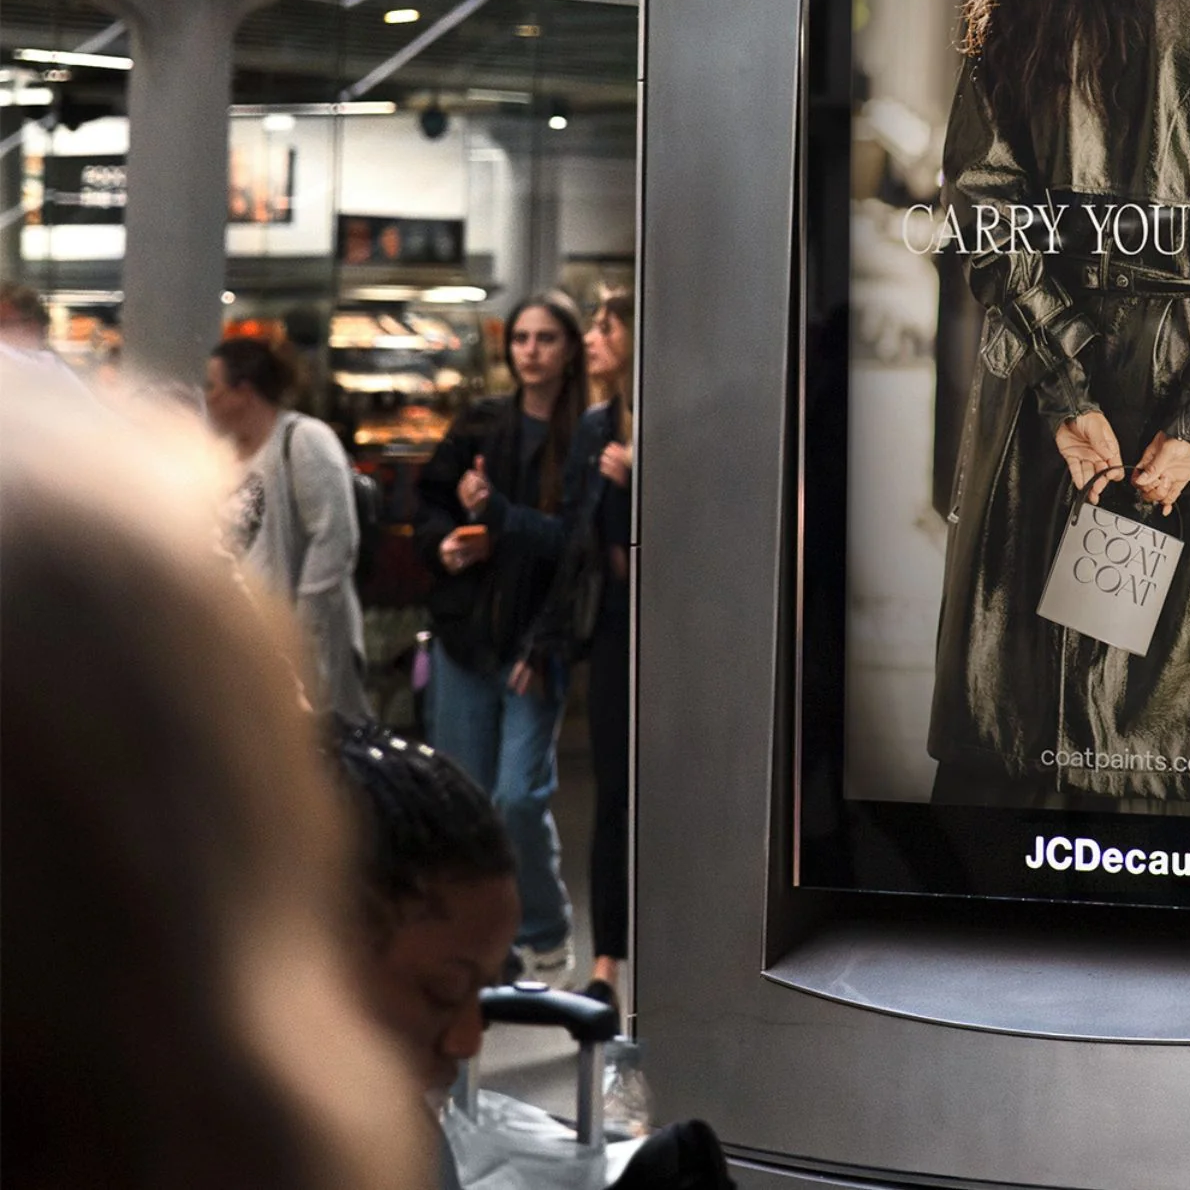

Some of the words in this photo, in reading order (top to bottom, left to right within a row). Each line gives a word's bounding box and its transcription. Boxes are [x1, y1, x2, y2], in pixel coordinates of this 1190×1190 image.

[902, 204, 1068, 256] CARRY
[1083, 528, 1168, 578] COAT
[1073, 556, 1157, 607] COAT
